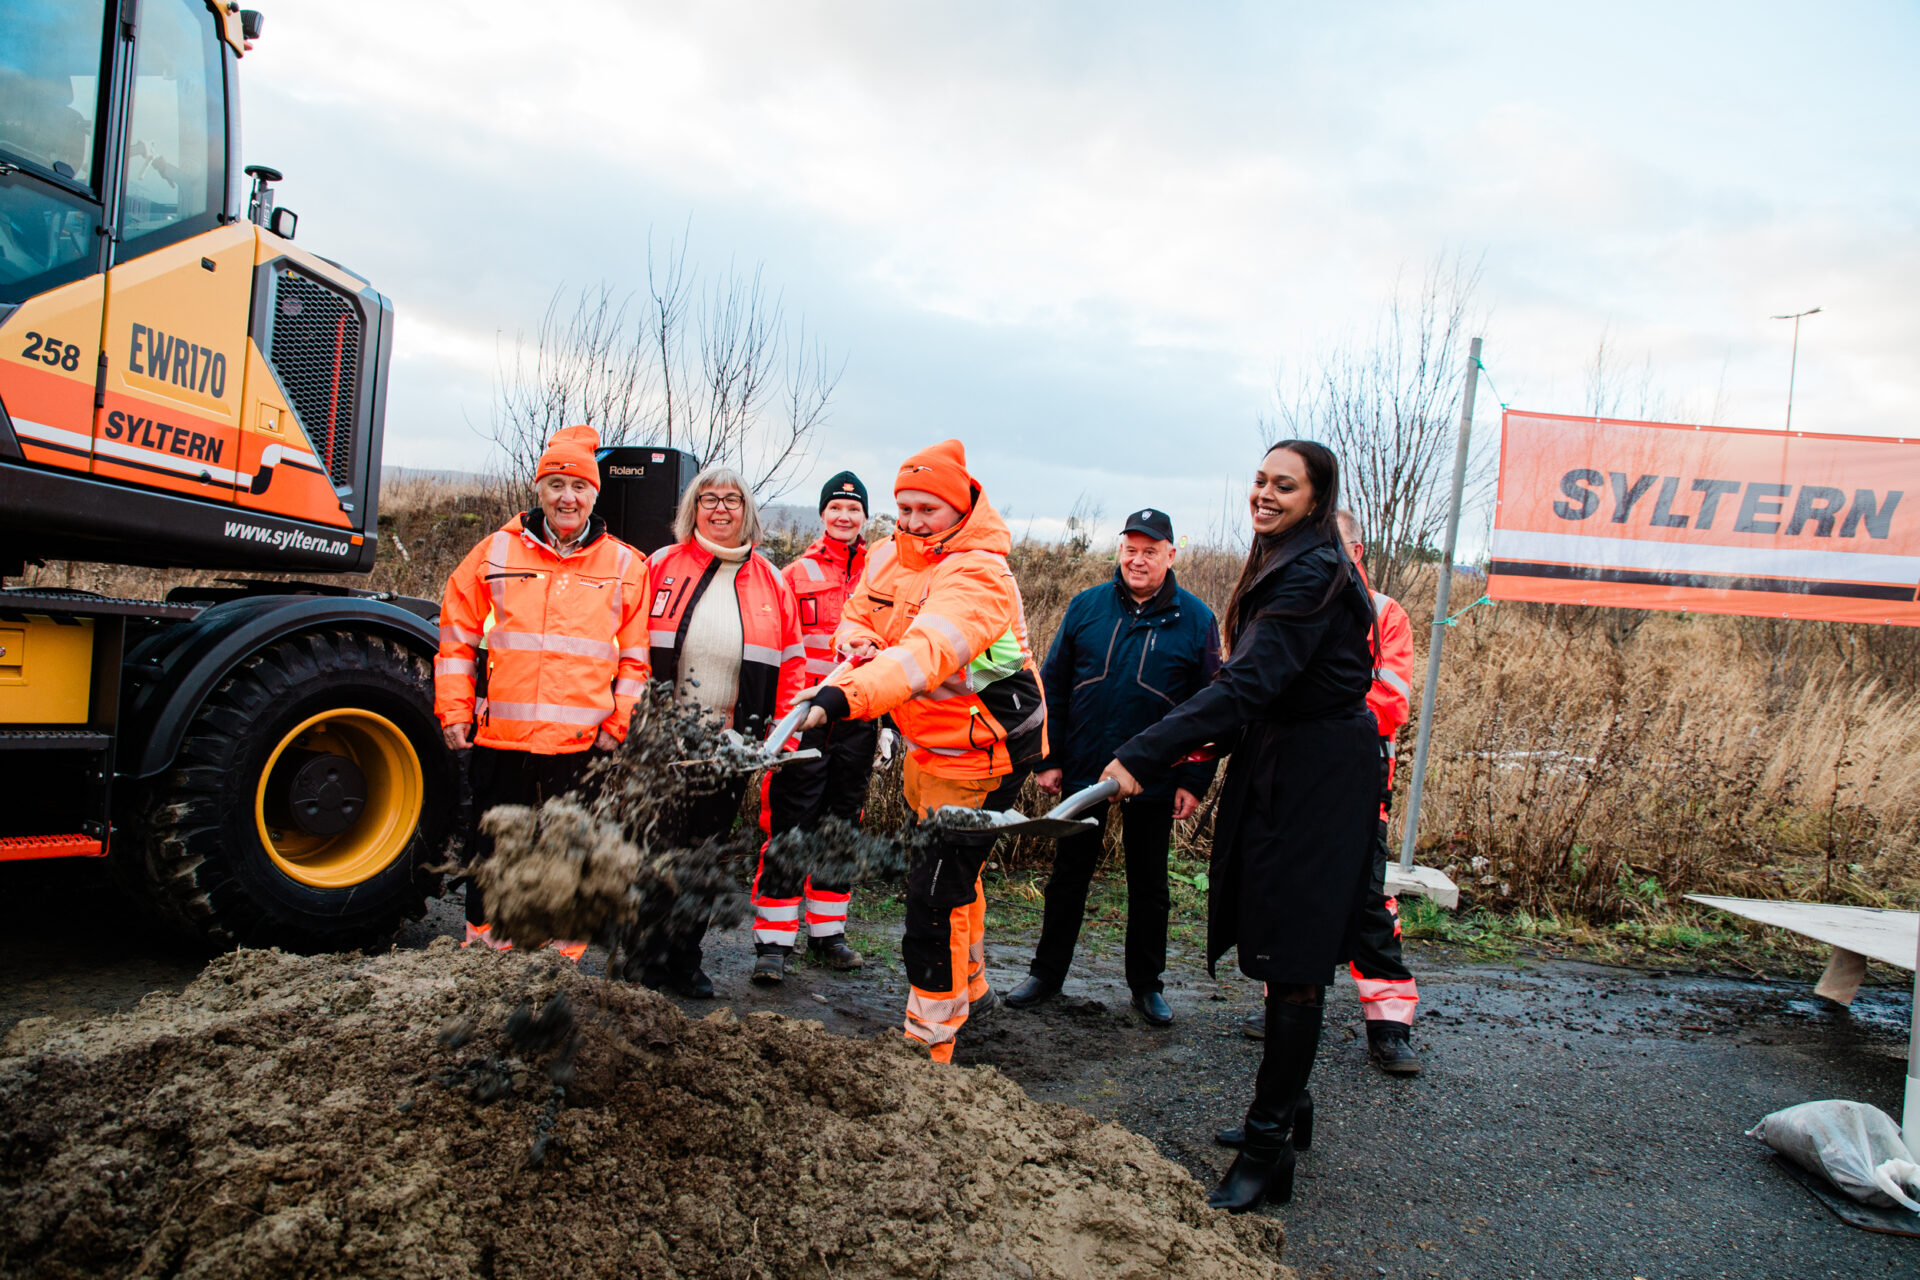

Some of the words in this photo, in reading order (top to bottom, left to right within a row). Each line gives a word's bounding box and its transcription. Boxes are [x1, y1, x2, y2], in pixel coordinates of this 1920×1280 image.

[21, 331, 81, 372] 258
[129, 322, 227, 399] EWR170
[105, 411, 224, 464] SYLTERN
[609, 465, 644, 476] Roland
[1552, 468, 1905, 540] SYLTERN
[224, 521, 349, 556] www.syltern.no
